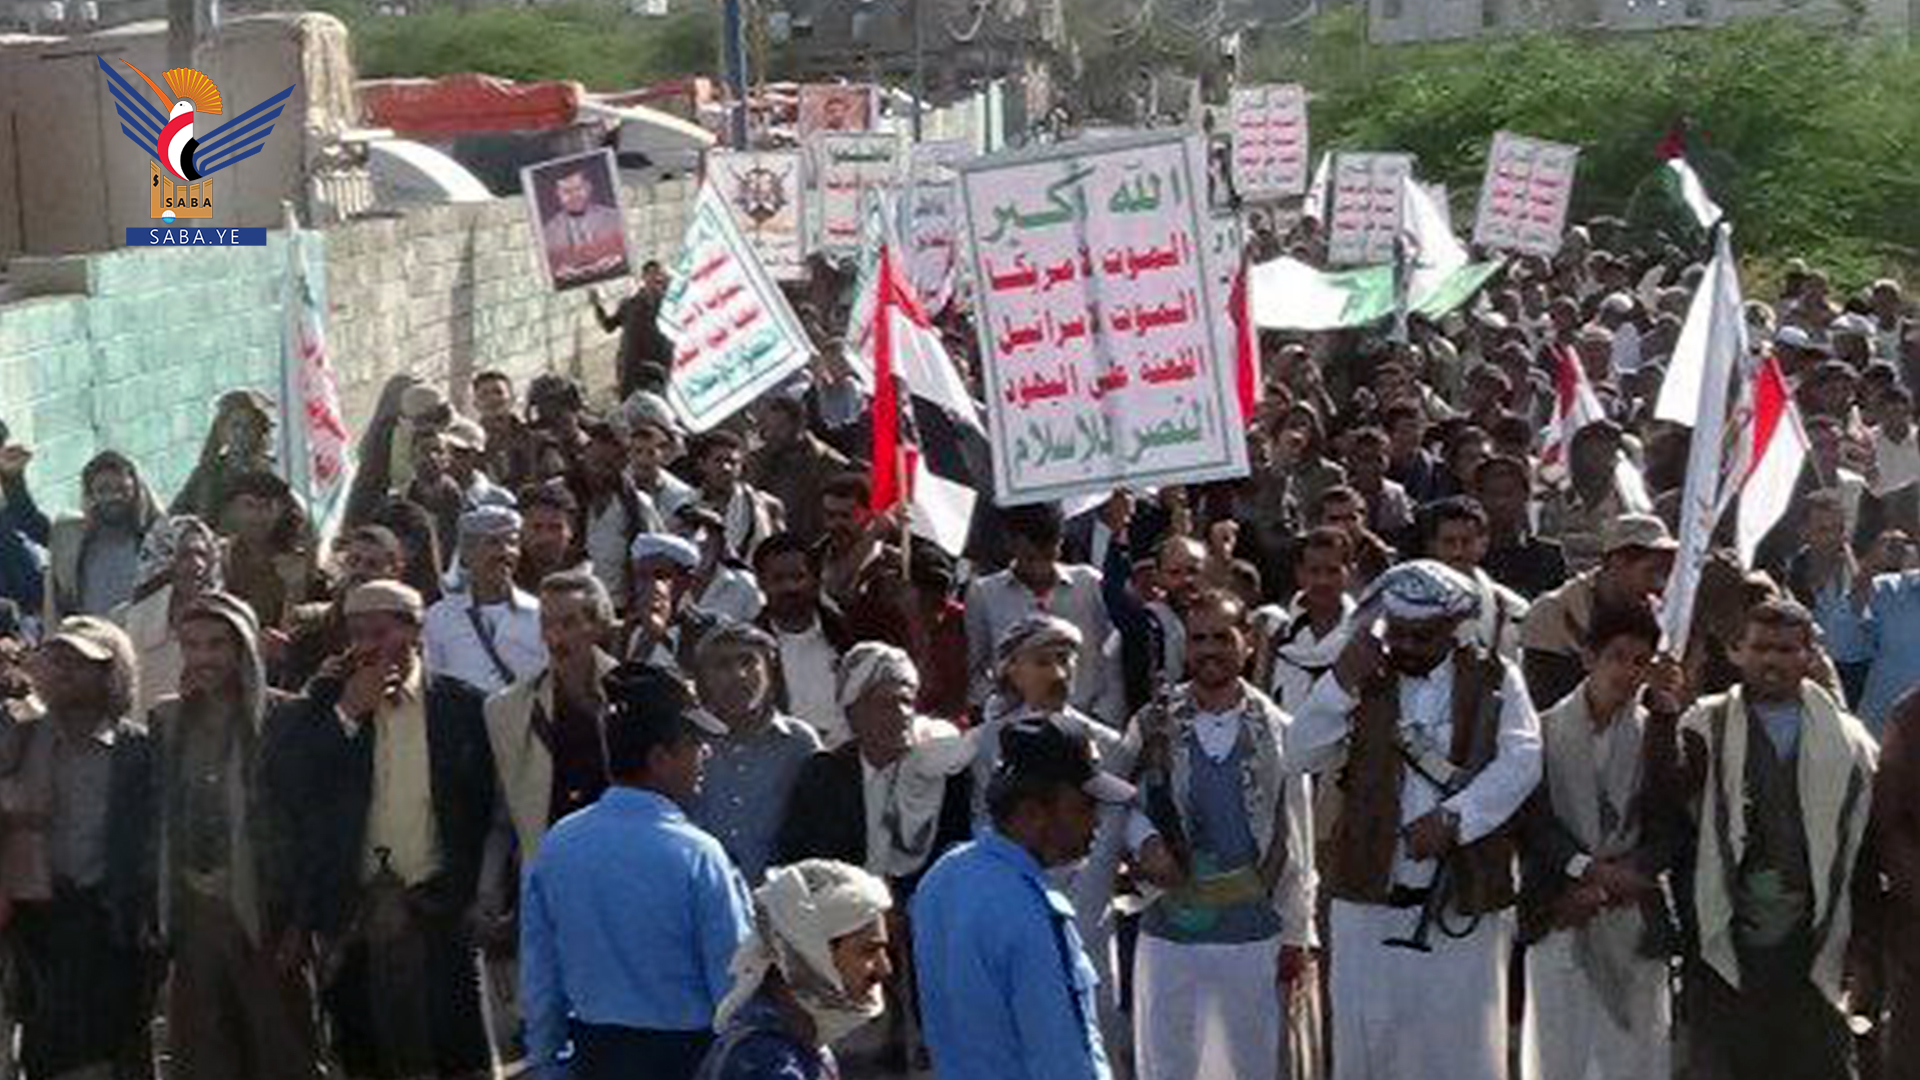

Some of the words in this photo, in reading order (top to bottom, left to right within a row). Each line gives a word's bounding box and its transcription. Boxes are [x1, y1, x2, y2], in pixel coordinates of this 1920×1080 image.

[1108, 161, 1181, 213] الله
[1103, 231, 1190, 280] الموت
[1110, 288, 1198, 336] الموت
[1004, 363, 1078, 410] اليهود
[1088, 360, 1128, 399] على
[1139, 345, 1206, 384] اللعنة
[1126, 396, 1215, 464] النصر
